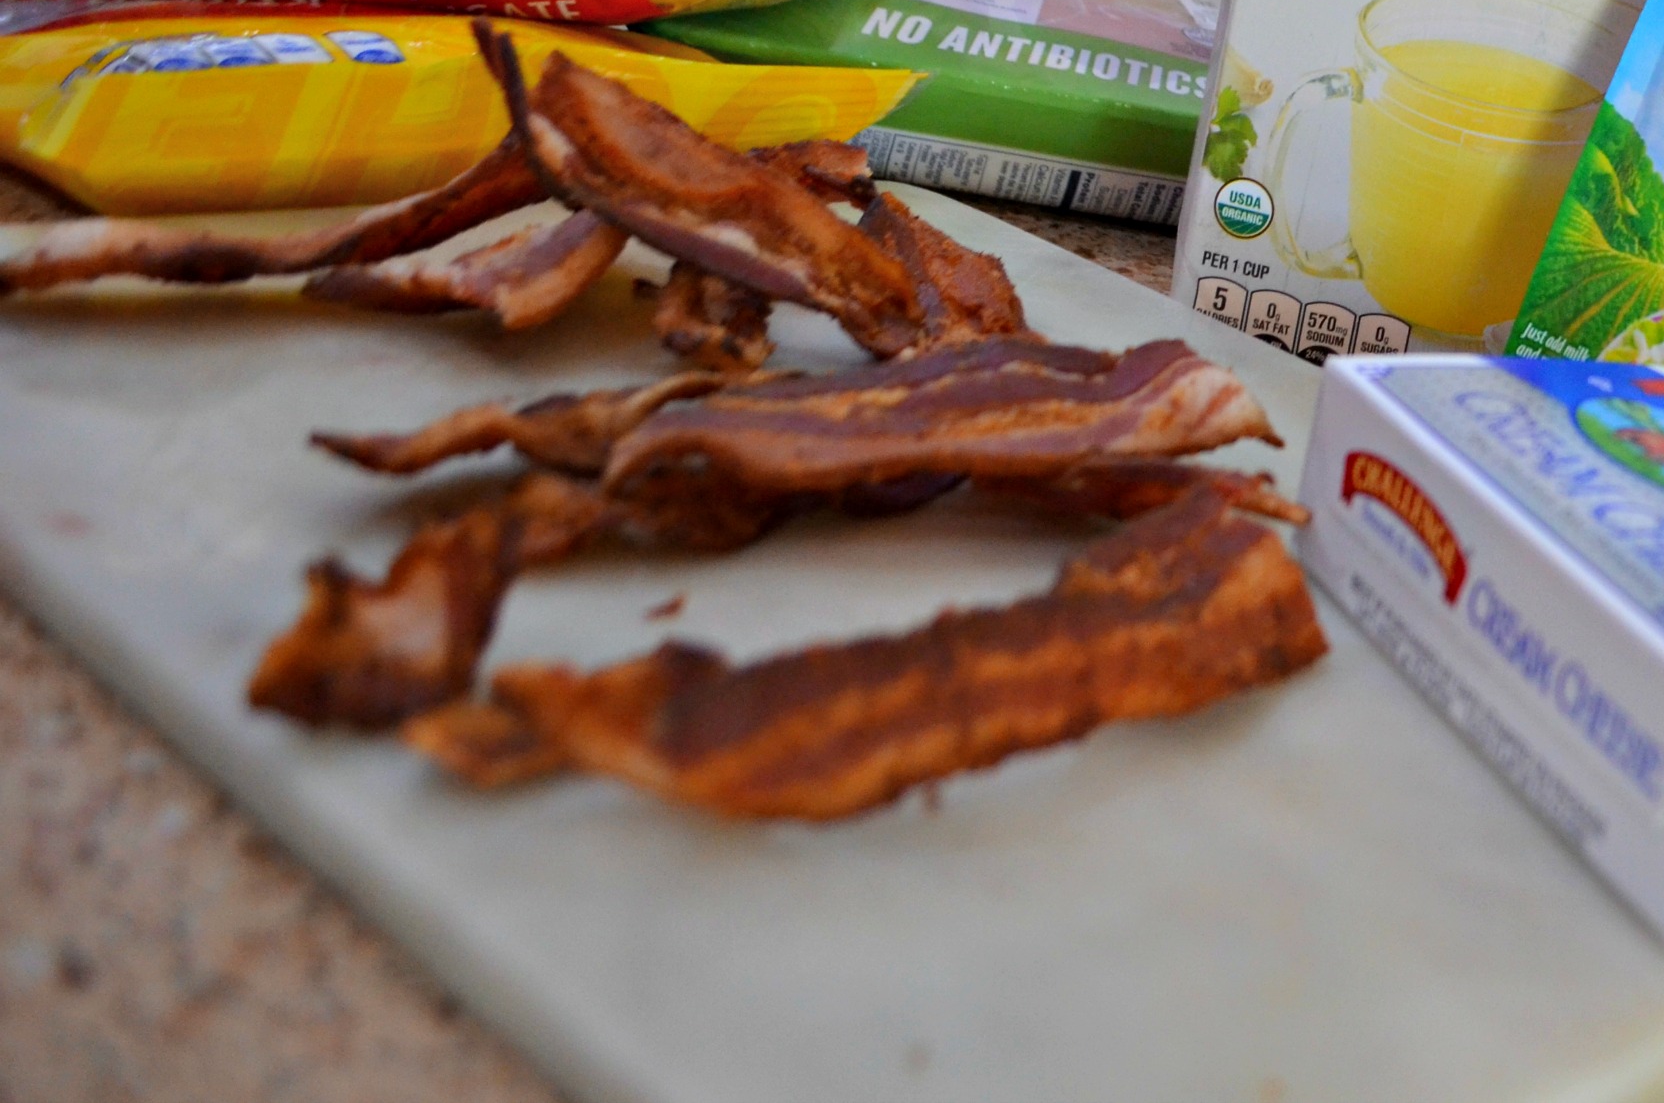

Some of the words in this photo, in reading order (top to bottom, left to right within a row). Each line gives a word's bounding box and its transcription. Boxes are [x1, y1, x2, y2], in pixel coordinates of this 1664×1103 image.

[861, 7, 933, 45] NO
[1229, 190, 1261, 209] USDA
[1222, 206, 1263, 225] ORGANIC
[1202, 251, 1229, 270] PER
[1233, 259, 1238, 273] 1
[1242, 263, 1270, 279] CUP
[1213, 287, 1228, 311] 5
[1252, 318, 1271, 331] SAT
[1273, 322, 1291, 335] FAT
[1306, 330, 1345, 347] SODIUM
[1520, 322, 1547, 345] Just
[1545, 336, 1567, 353] add
[1563, 345, 1589, 362] milk
